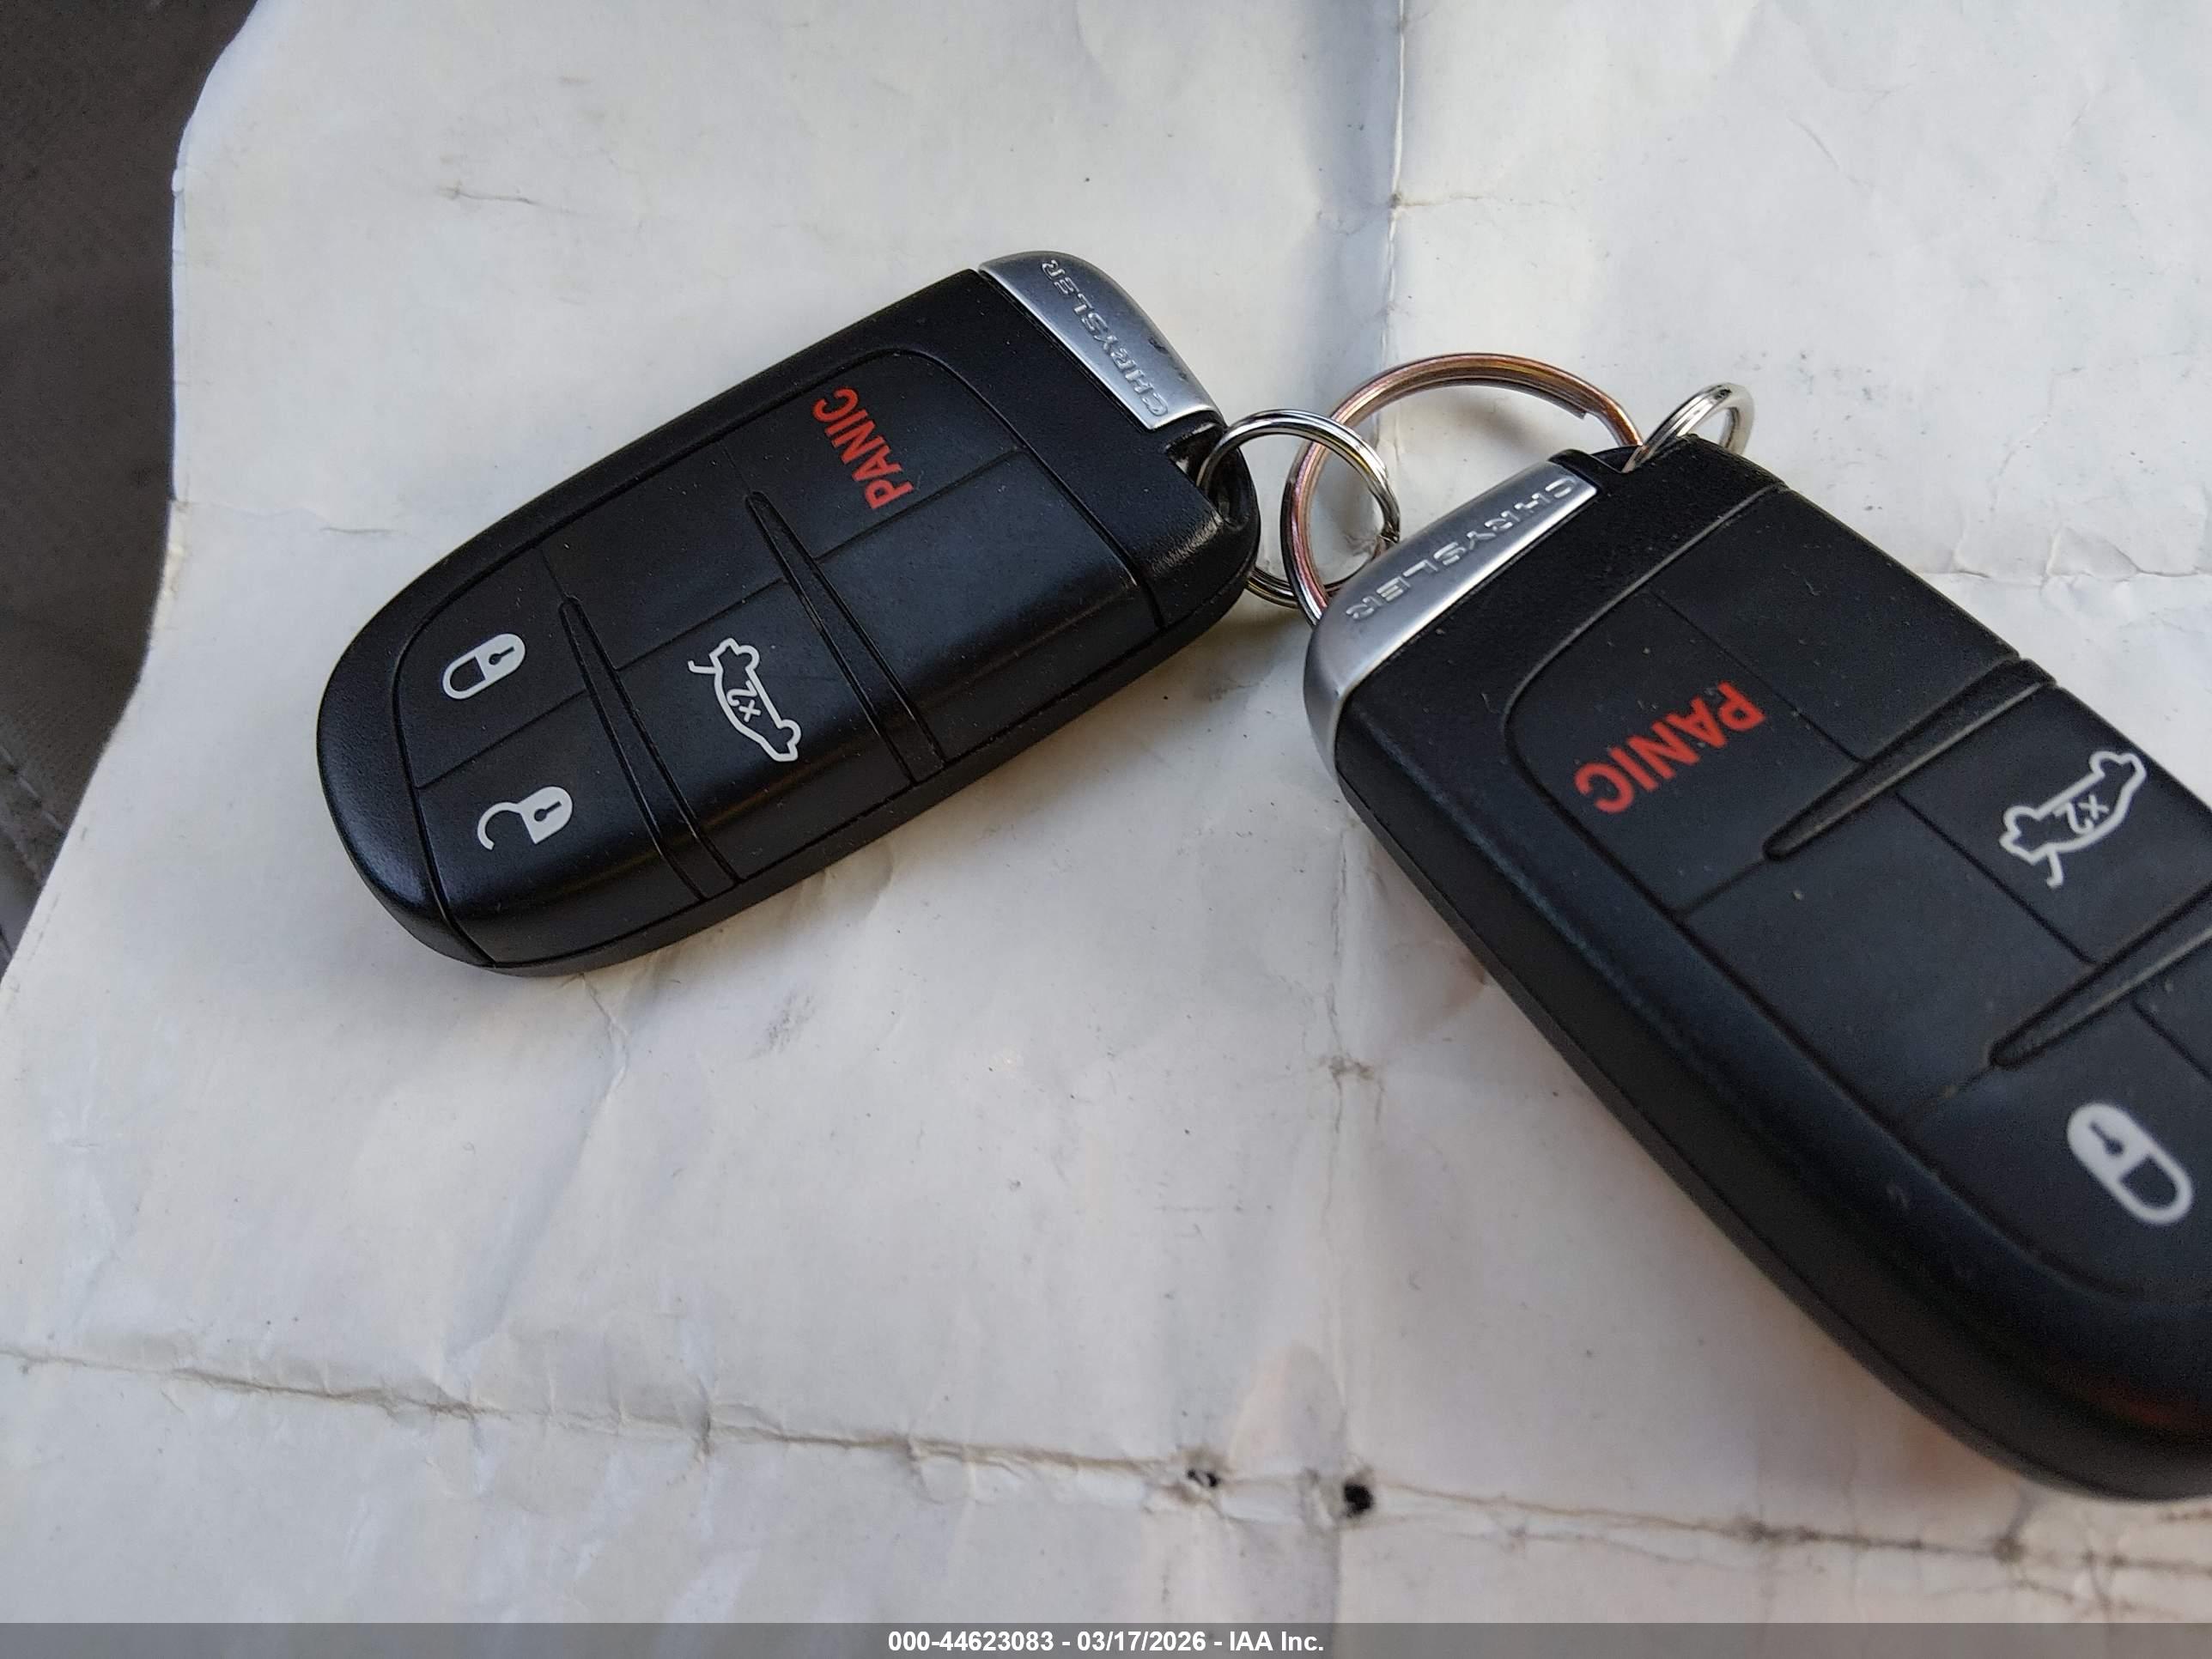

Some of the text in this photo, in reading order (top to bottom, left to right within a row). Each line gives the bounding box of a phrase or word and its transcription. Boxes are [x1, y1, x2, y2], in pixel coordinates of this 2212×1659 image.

[1041, 259, 1169, 416] CHRYSLER
[812, 387, 914, 509] PANIC
[1345, 474, 1577, 620] CHRYSLER
[1574, 680, 1765, 813] PANIC
